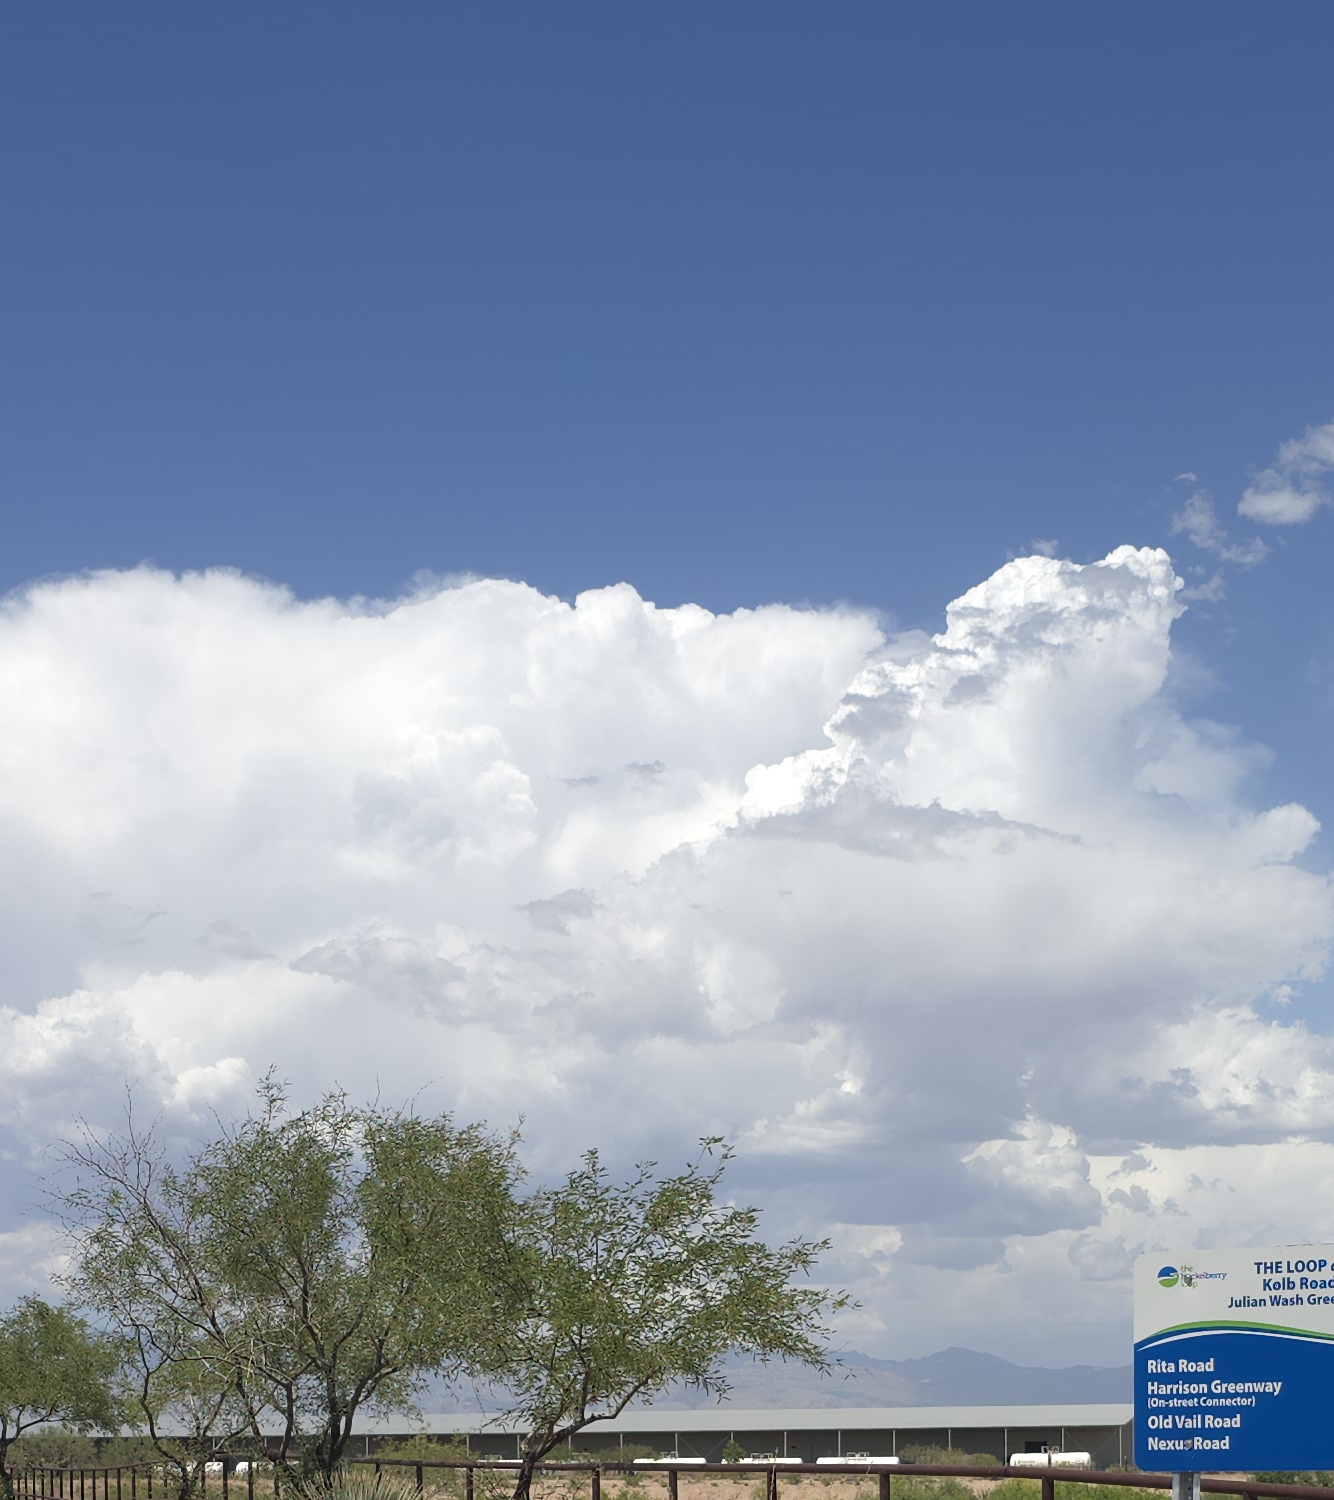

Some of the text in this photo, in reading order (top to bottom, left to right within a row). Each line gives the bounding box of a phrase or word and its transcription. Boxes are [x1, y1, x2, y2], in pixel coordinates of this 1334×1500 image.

[1254, 1260, 1283, 1275] THE
[1286, 1259, 1327, 1274] LOOP
[1263, 1277, 1296, 1291] Kolb
[1228, 1295, 1267, 1309] Julian
[1269, 1293, 1304, 1307] Wash
[1147, 1358, 1175, 1374] Rita
[1178, 1357, 1215, 1373] Road
[1147, 1380, 1208, 1395] Harrison
[1210, 1379, 1282, 1396] Greenway
[1147, 1395, 1256, 1409] (On-street Connector)
[1147, 1414, 1173, 1429] Old
[1175, 1414, 1202, 1429] Vail
[1204, 1413, 1241, 1429] Road
[1193, 1435, 1230, 1450] Road
